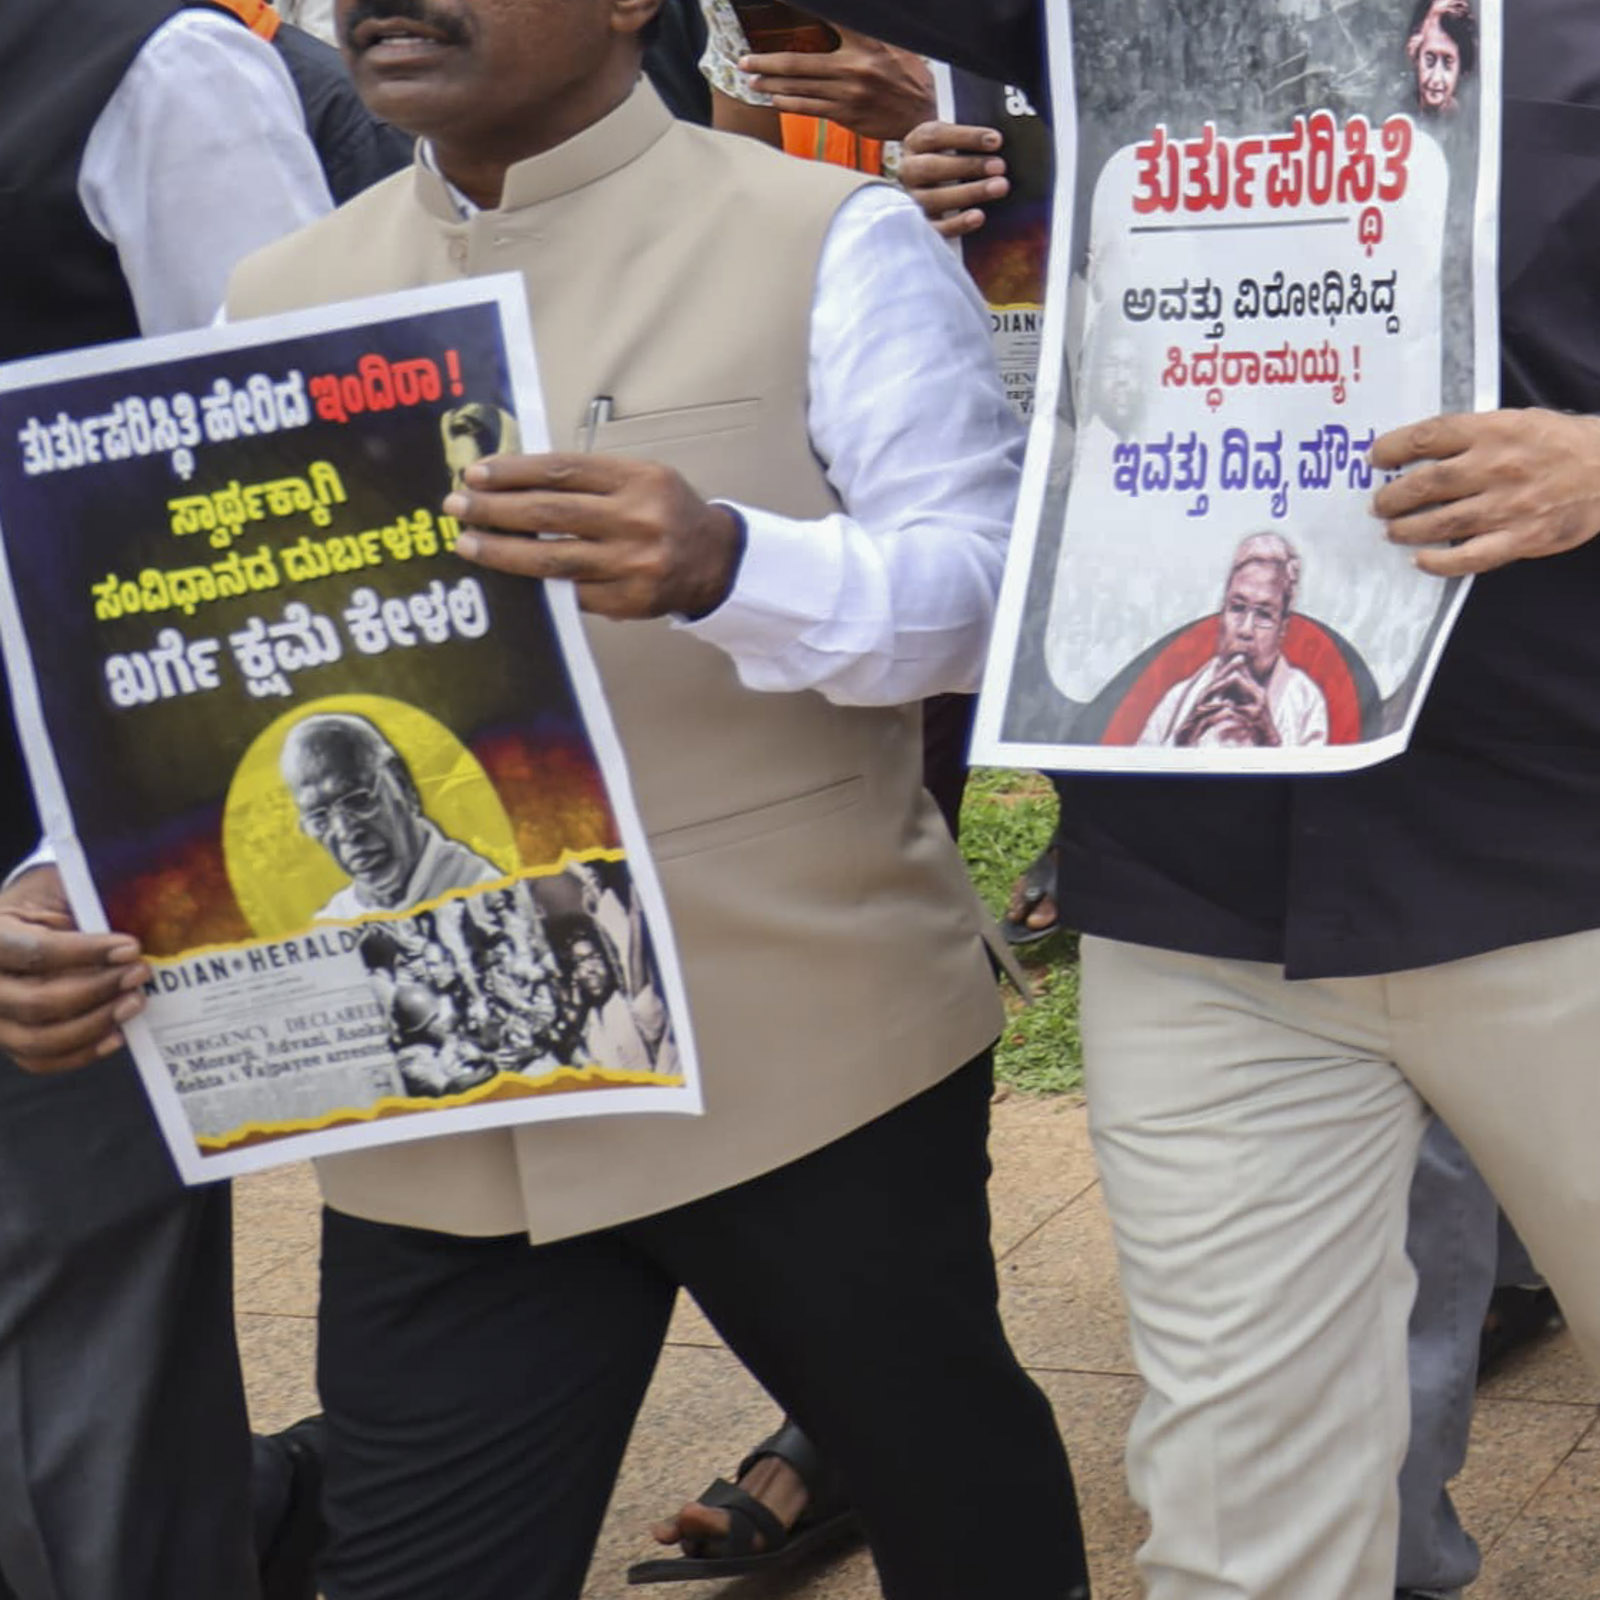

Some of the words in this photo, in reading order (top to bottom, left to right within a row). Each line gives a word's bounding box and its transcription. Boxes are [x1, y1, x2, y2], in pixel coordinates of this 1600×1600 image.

[1132, 113, 1413, 258] ತುರ್ತುಪರಿಸ್ಥಿತಿ
[1123, 278, 1225, 339] ಅವತ್ತು
[1233, 270, 1400, 334] ವಿರೋಧಿಸಿದ್ದ
[18, 392, 201, 480] ತುರ್ತುಪರಿಸ್ಥಿತಿ
[201, 369, 310, 441] ಹೇರಿದ
[309, 353, 441, 423] ಇಂದಿರಾ
[1113, 431, 1209, 517] ಇವತ್ತು
[1220, 427, 1289, 519] ದಿವ್ಯ
[92, 545, 279, 620] ಸಂವಿಧಾನದ
[280, 509, 438, 581] ದುರ್ಬಳಕೆ
[105, 628, 220, 707] ಖರ್ಗೆ
[229, 602, 342, 697] ಕ್ಷಮೆ
[344, 576, 489, 654] ಕೇಳಲಿ
[247, 928, 357, 972] HERALD
